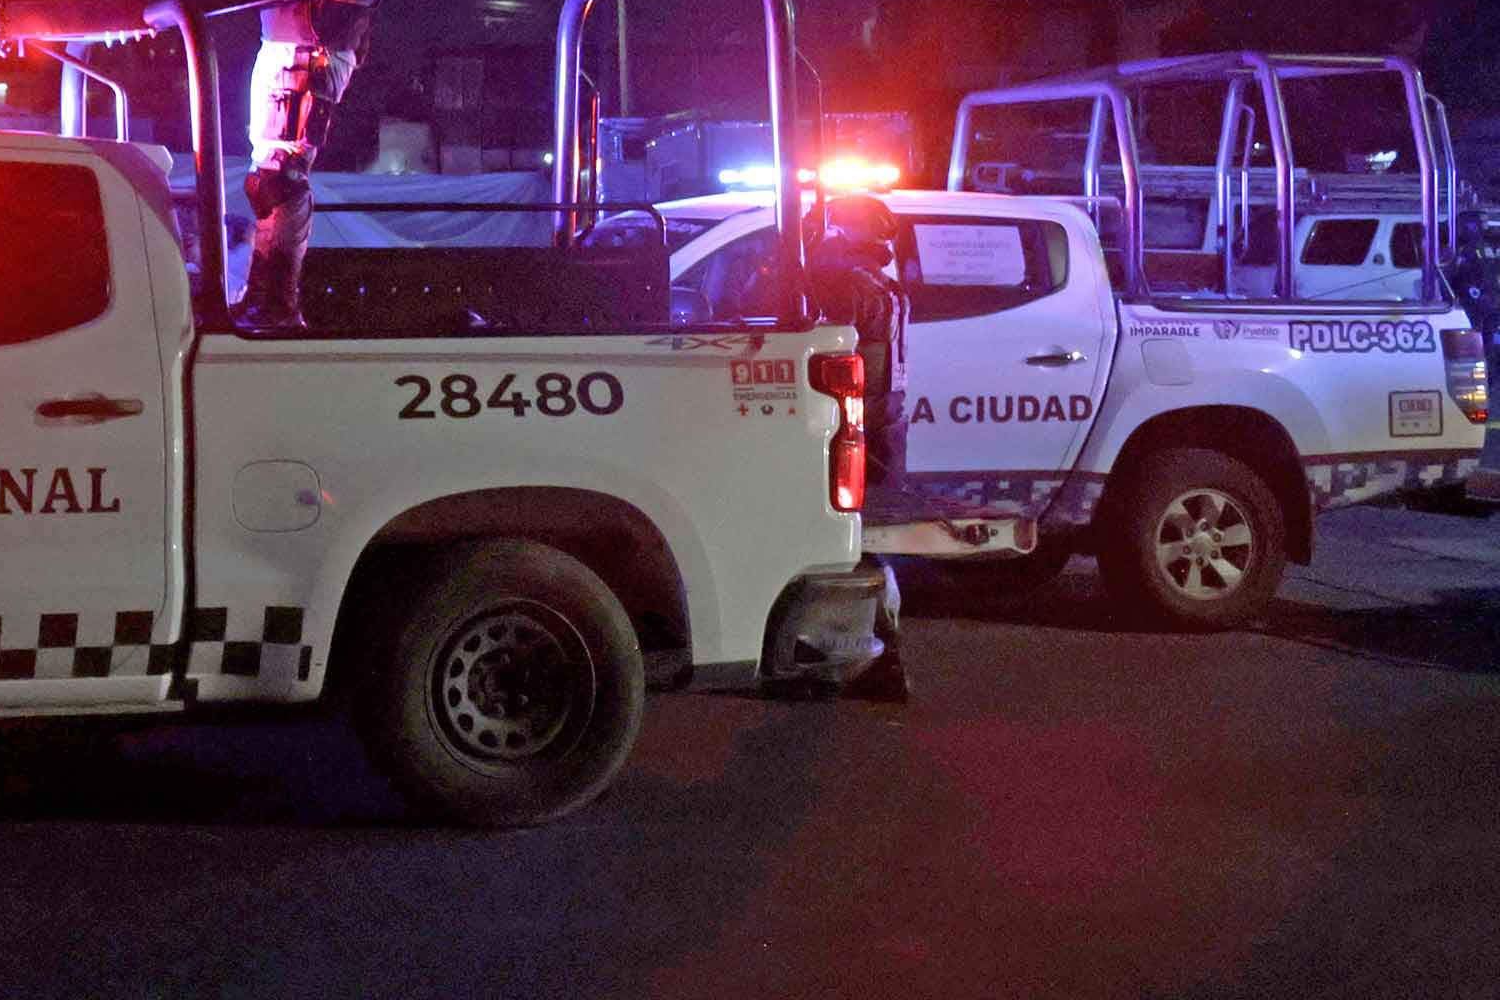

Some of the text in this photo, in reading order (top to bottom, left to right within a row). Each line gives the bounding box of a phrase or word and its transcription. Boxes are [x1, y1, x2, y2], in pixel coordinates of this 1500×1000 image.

[1130, 326, 1200, 337] IMPARABLE
[1289, 320, 1436, 352] PDLC-362
[732, 361, 795, 384] 911
[394, 371, 625, 420] 28480
[948, 394, 1094, 424] CIUDAD
